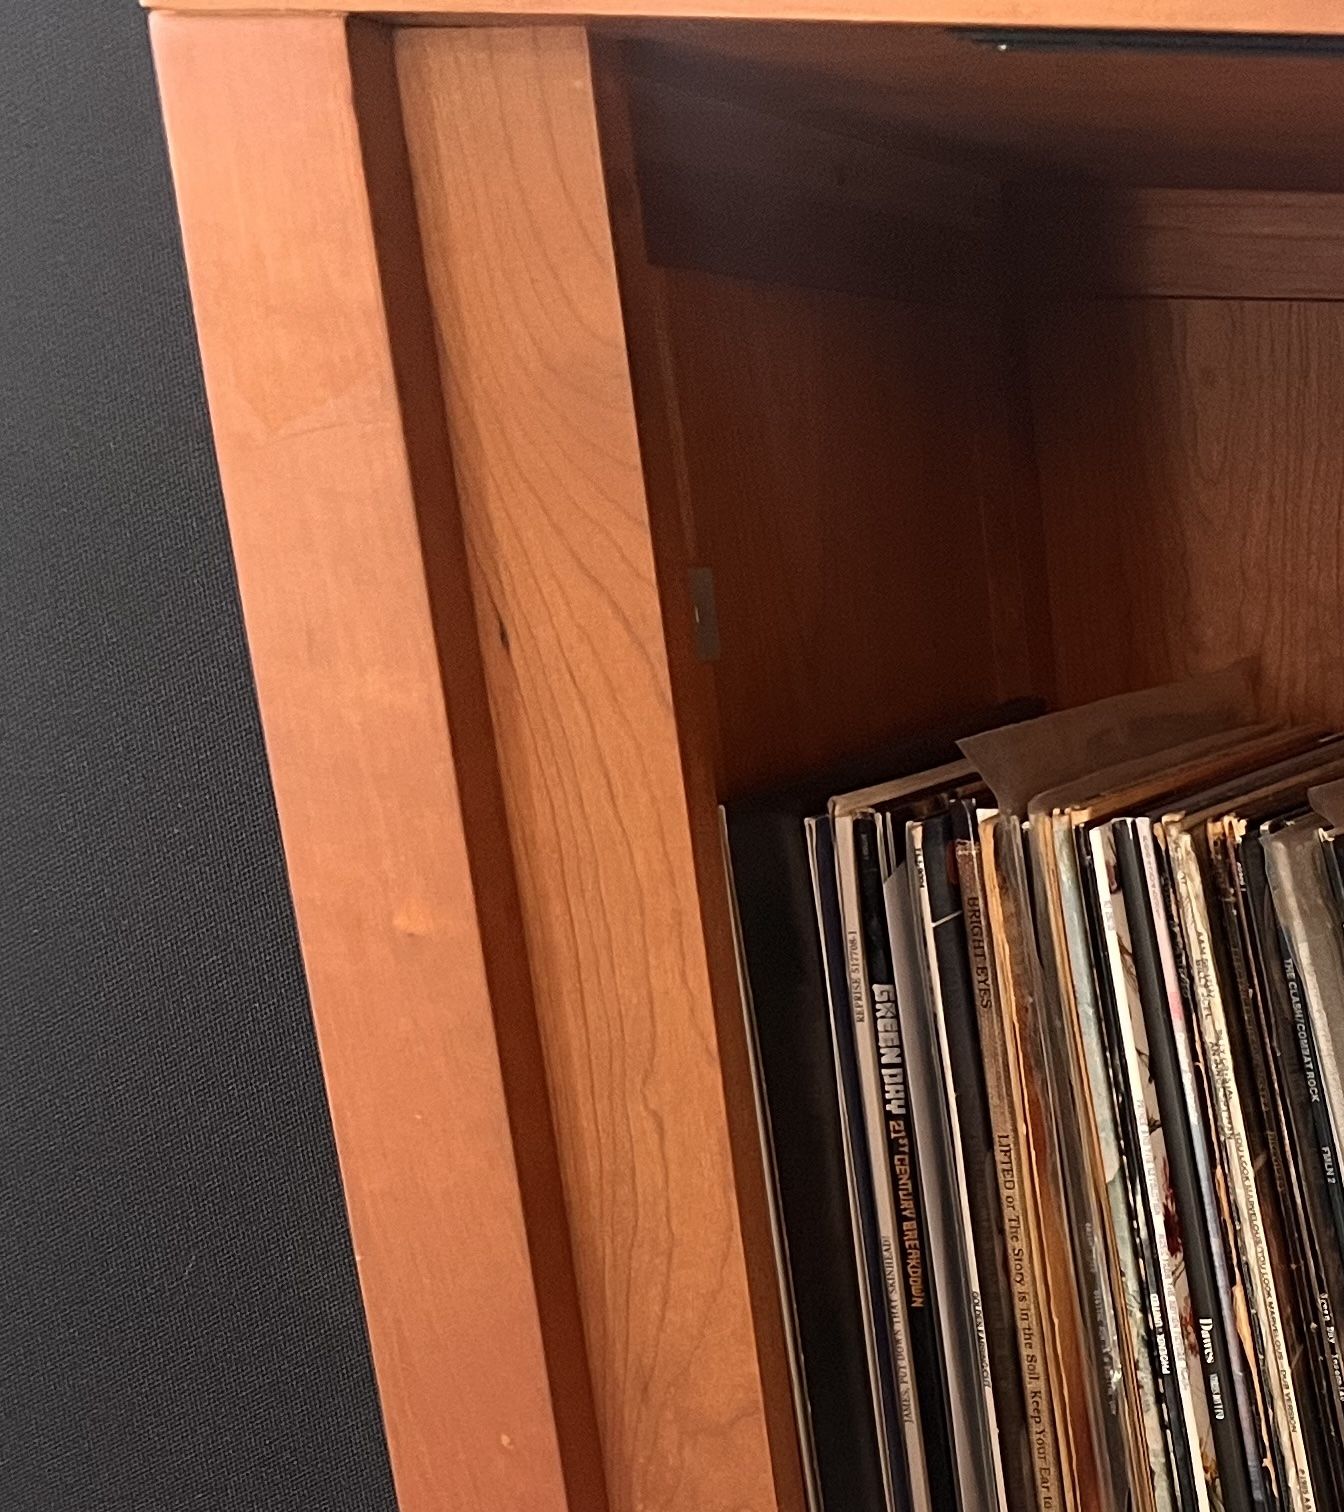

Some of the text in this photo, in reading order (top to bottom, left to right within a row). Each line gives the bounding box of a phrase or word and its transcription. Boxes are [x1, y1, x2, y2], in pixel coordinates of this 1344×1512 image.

[966, 895, 992, 1010] BRIGHT EYES
[846, 928, 865, 1023] REPRISE 517708-1
[871, 981, 909, 1116] GREEN DAY
[1282, 957, 1320, 1103] THE CLASH/COMBAT ROCK
[997, 1133, 1016, 1190] LIFTED
[1320, 1145, 1336, 1185] FMLN 2
[888, 1119, 926, 1308] 21ST CENTURY BREAKDOWN
[1004, 1194, 1016, 1211] or
[1007, 1215, 1022, 1244] The
[1009, 1246, 1027, 1287] Story
[971, 1289, 984, 1327] GOLDEN
[1016, 1288, 1029, 1303] is
[1238, 1154, 1250, 1182] LOOK
[1260, 1272, 1272, 1300] LOOK
[1284, 1392, 1298, 1433] VERSION
[881, 1234, 913, 1424] JAMES, PUT DOWN THAT SKINHEAD!
[1019, 1306, 1032, 1322] in
[1149, 1292, 1170, 1374] PHOENIX UNITED
[1325, 1324, 1337, 1344] Day
[1021, 1325, 1036, 1350] the
[1198, 1316, 1219, 1364] Dawes
[1027, 1388, 1045, 1425] Keep
[1033, 1428, 1049, 1463] Your
[1038, 1465, 1053, 1490] Ear
[1042, 1493, 1055, 1509] to
